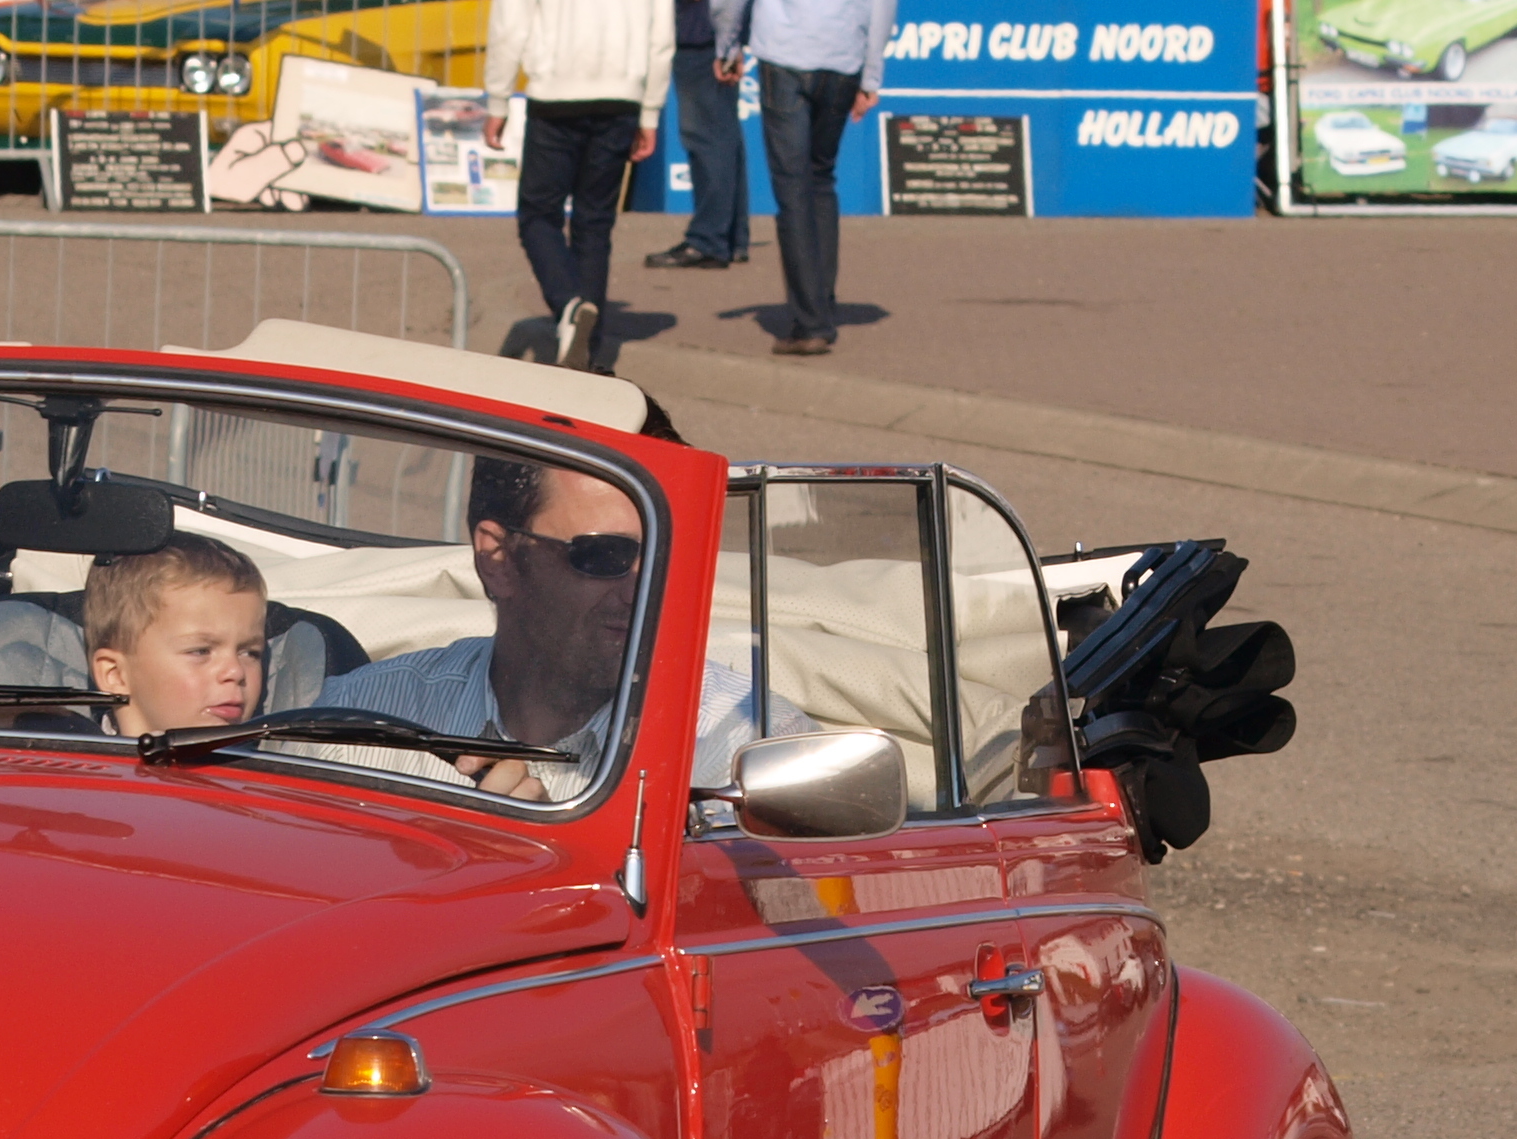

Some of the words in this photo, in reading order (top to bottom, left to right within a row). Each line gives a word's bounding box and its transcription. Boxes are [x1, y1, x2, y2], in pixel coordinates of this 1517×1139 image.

[988, 22, 1079, 61] CLUB
[1089, 24, 1214, 63] NOORD
[1078, 110, 1240, 148] HOLLAND
